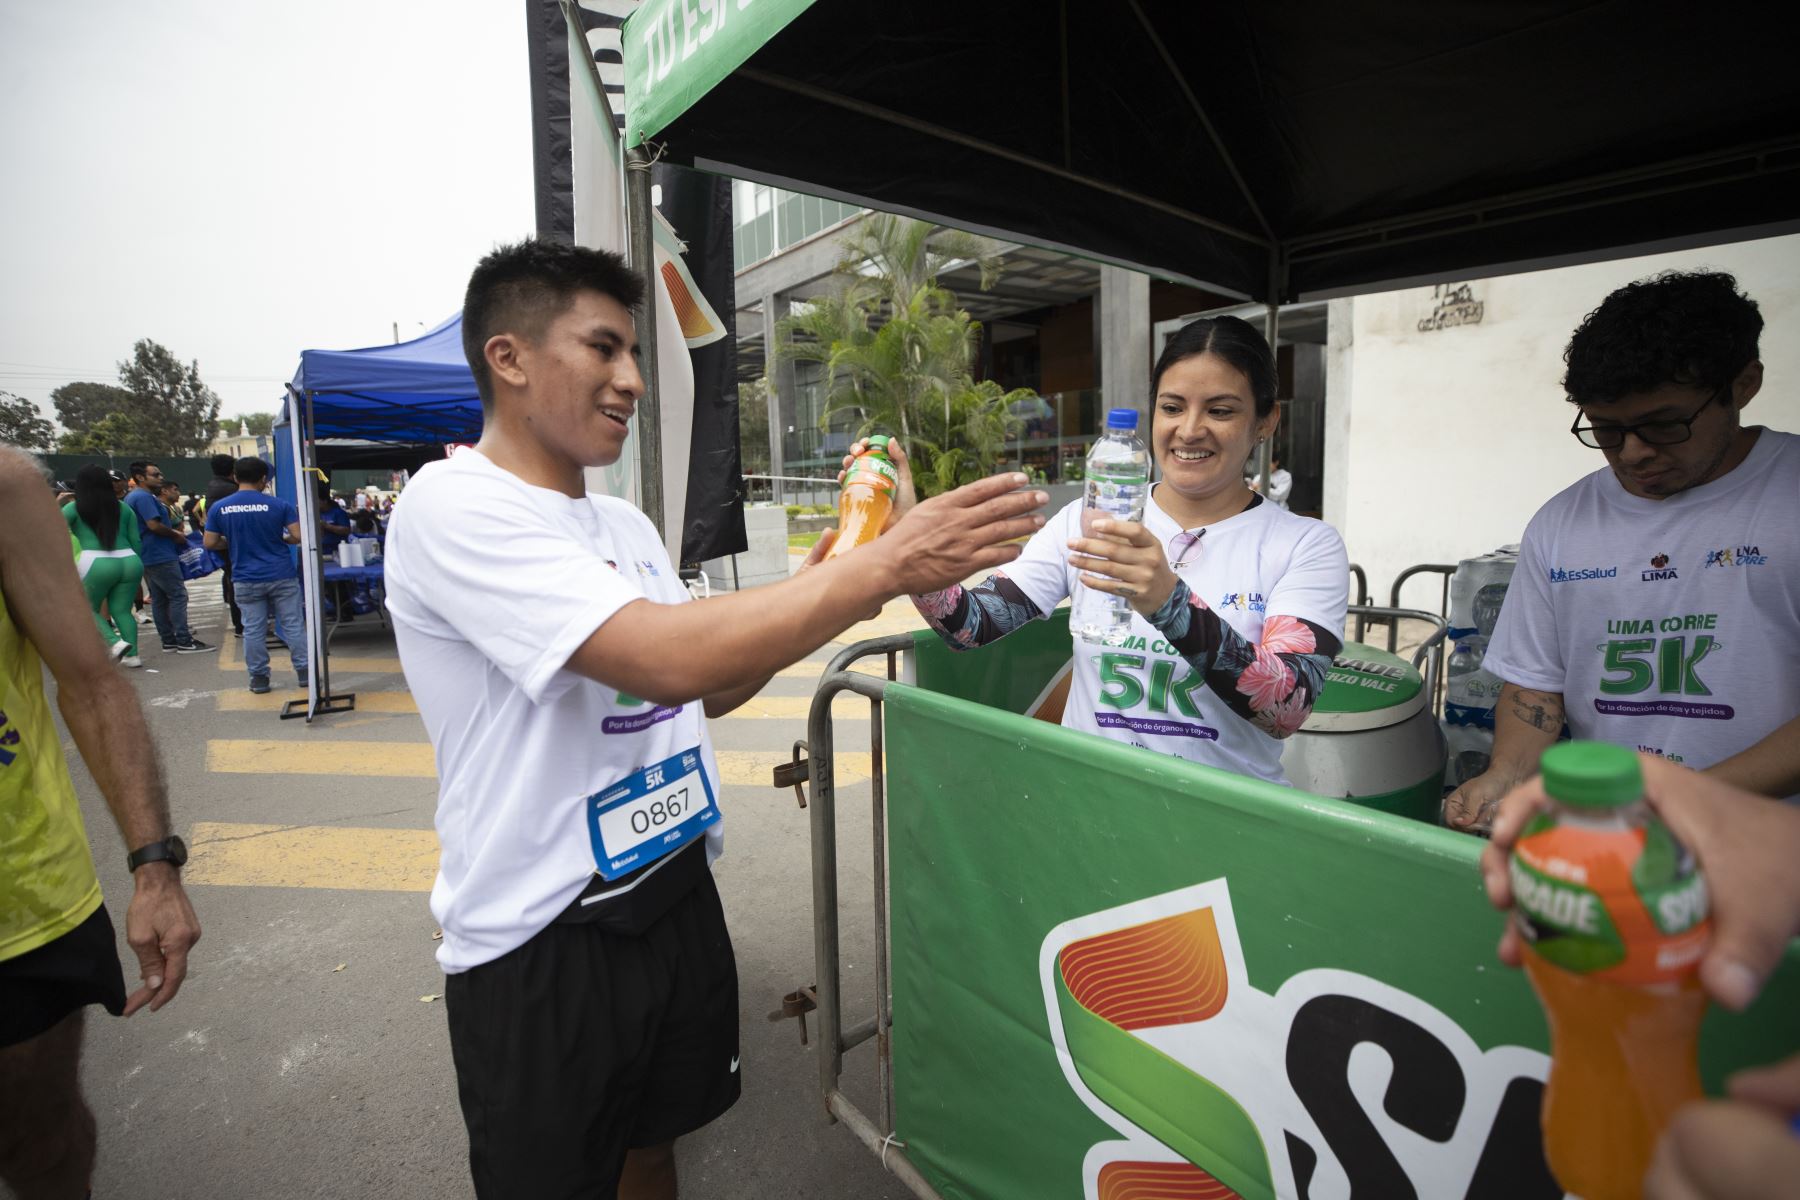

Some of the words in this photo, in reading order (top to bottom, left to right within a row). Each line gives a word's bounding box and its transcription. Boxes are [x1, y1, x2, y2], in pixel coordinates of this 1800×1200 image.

[220, 503, 269, 515] LICENCIADO
[1568, 566, 1617, 581] EsSalud
[1641, 570, 1679, 581] LIMA
[1607, 619, 1655, 634] LIMA
[1659, 614, 1718, 632] CORRE
[1151, 639, 1182, 657] CO
[1599, 634, 1715, 696] 5K
[1099, 652, 1205, 720] 5K
[1360, 677, 1398, 693] VALE
[1607, 703, 1616, 711] la
[1616, 704, 1655, 713] donación
[1691, 706, 1726, 717] tejidos
[608, 720, 624, 729] Por
[1143, 722, 1153, 730] de
[1153, 723, 1184, 733] órganos
[645, 769, 666, 790] 5K
[630, 786, 689, 834] 0867
